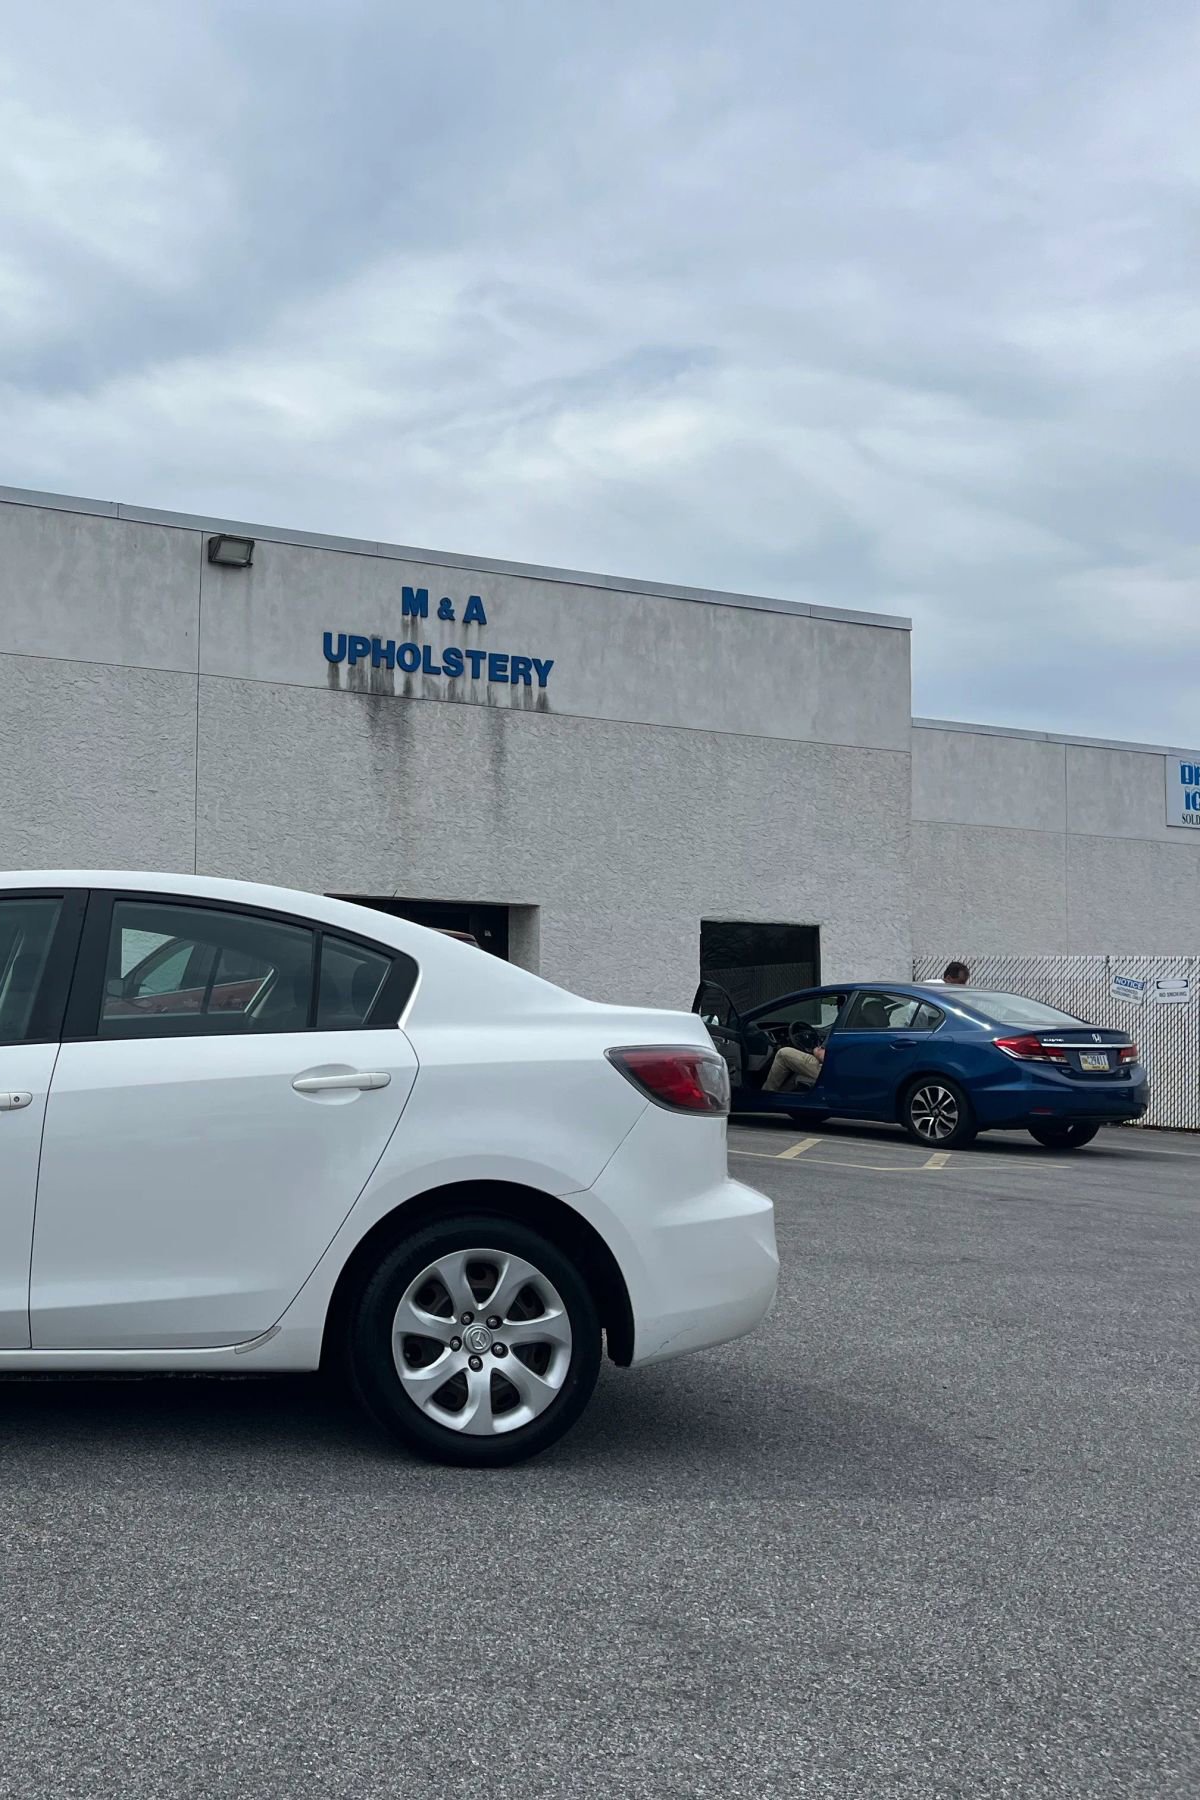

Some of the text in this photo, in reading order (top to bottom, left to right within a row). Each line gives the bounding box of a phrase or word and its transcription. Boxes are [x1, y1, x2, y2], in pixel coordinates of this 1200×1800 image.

[402, 586, 487, 625] M & A
[323, 632, 554, 687] UPHOLSTERY
[1115, 977, 1142, 990] NOTICE
